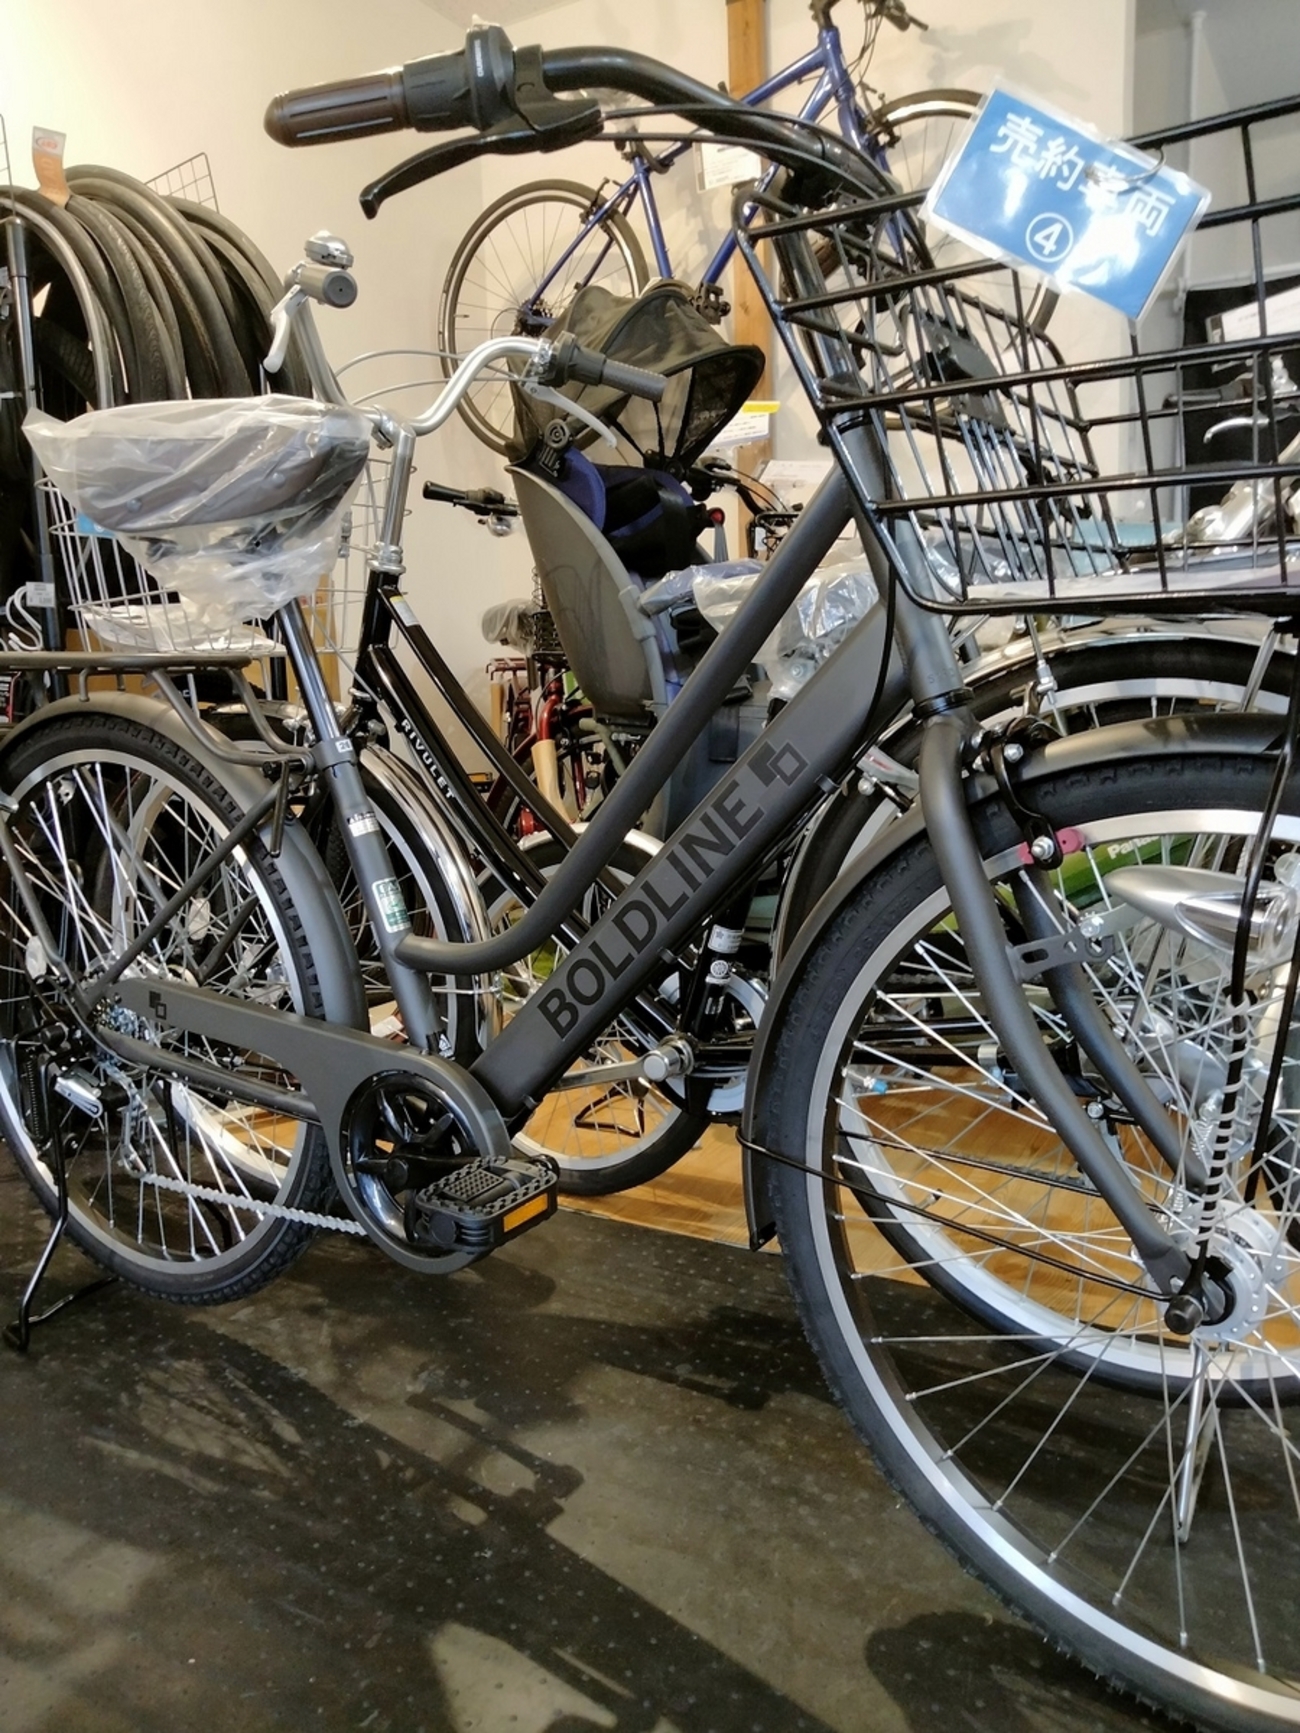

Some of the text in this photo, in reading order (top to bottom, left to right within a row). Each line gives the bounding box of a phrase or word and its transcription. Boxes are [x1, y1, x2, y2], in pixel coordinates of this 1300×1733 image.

[401, 719, 455, 798] RIVULET
[1107, 836, 1160, 860] Pana
[538, 779, 765, 1040] BOLDLINE
